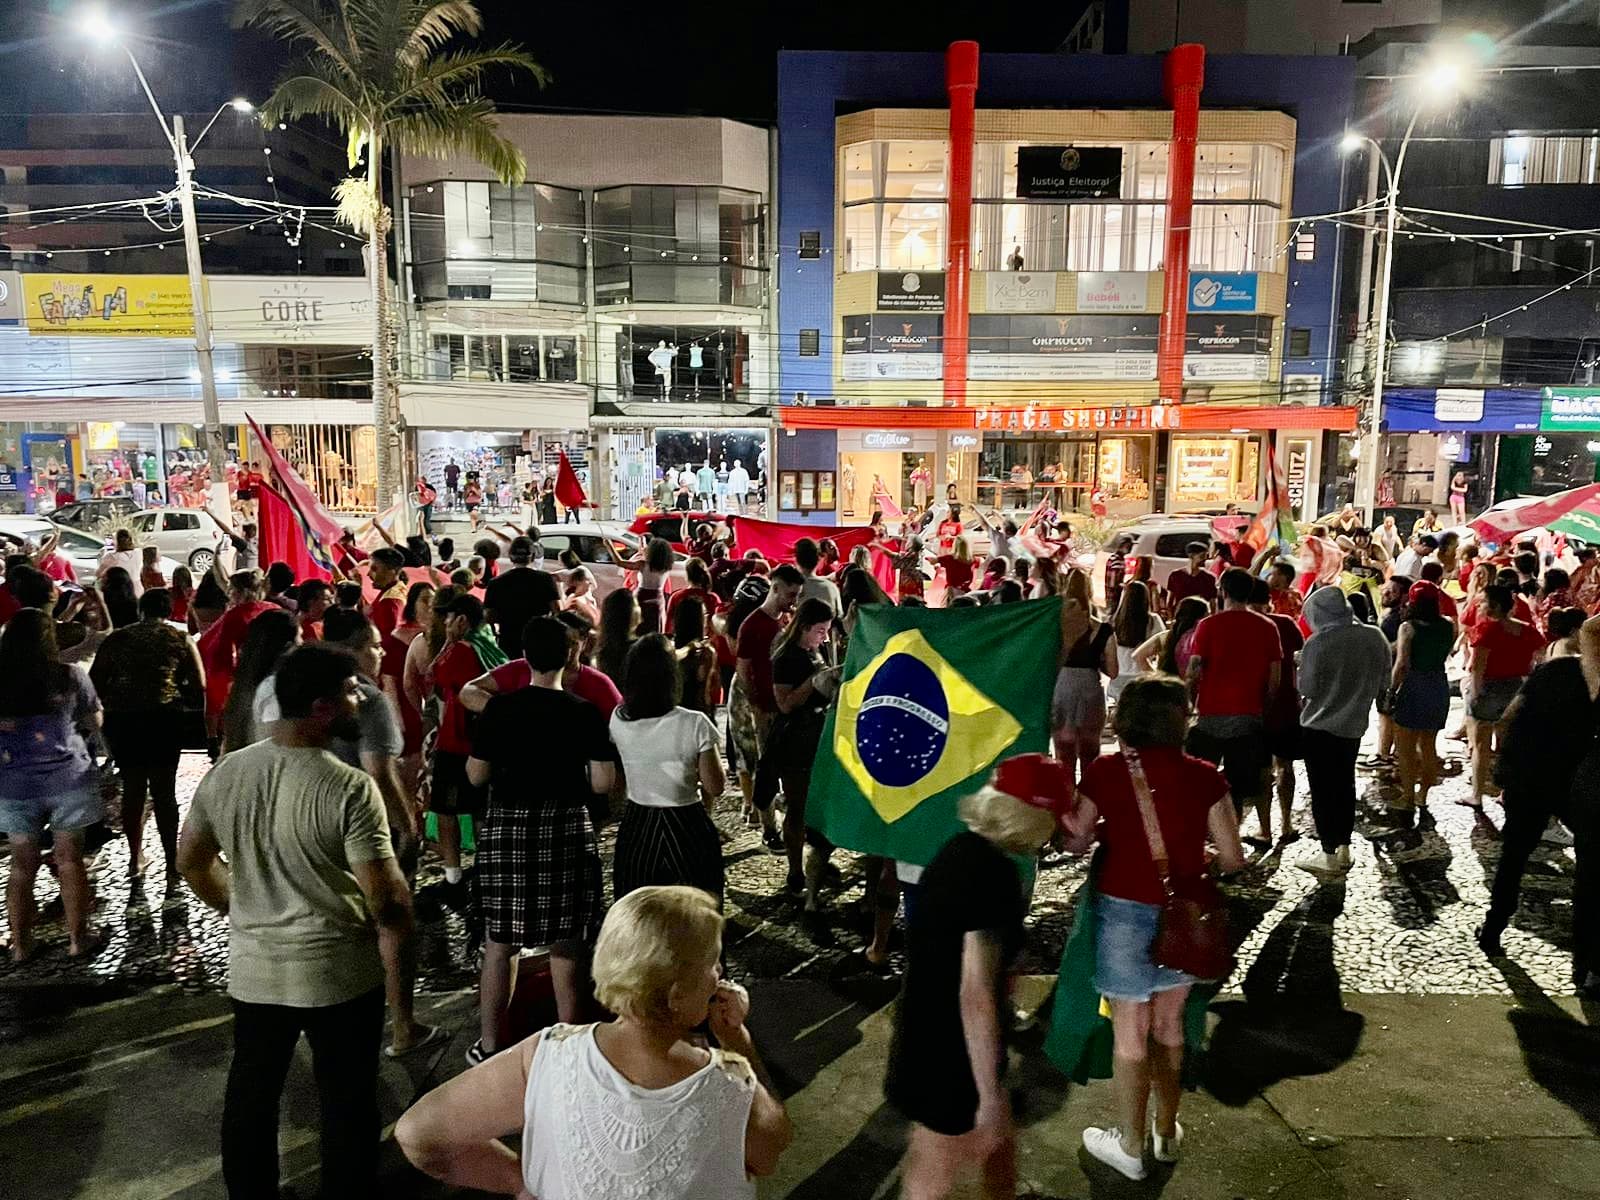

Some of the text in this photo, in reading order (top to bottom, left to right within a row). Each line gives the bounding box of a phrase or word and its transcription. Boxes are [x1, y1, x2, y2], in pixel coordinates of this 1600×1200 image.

[1031, 176, 1110, 187] Justiça Eleitoral
[262, 300, 324, 321] CORE
[974, 408, 1180, 429] PRAÇA SHOPPING
[1288, 452, 1305, 507] SCHUTZ
